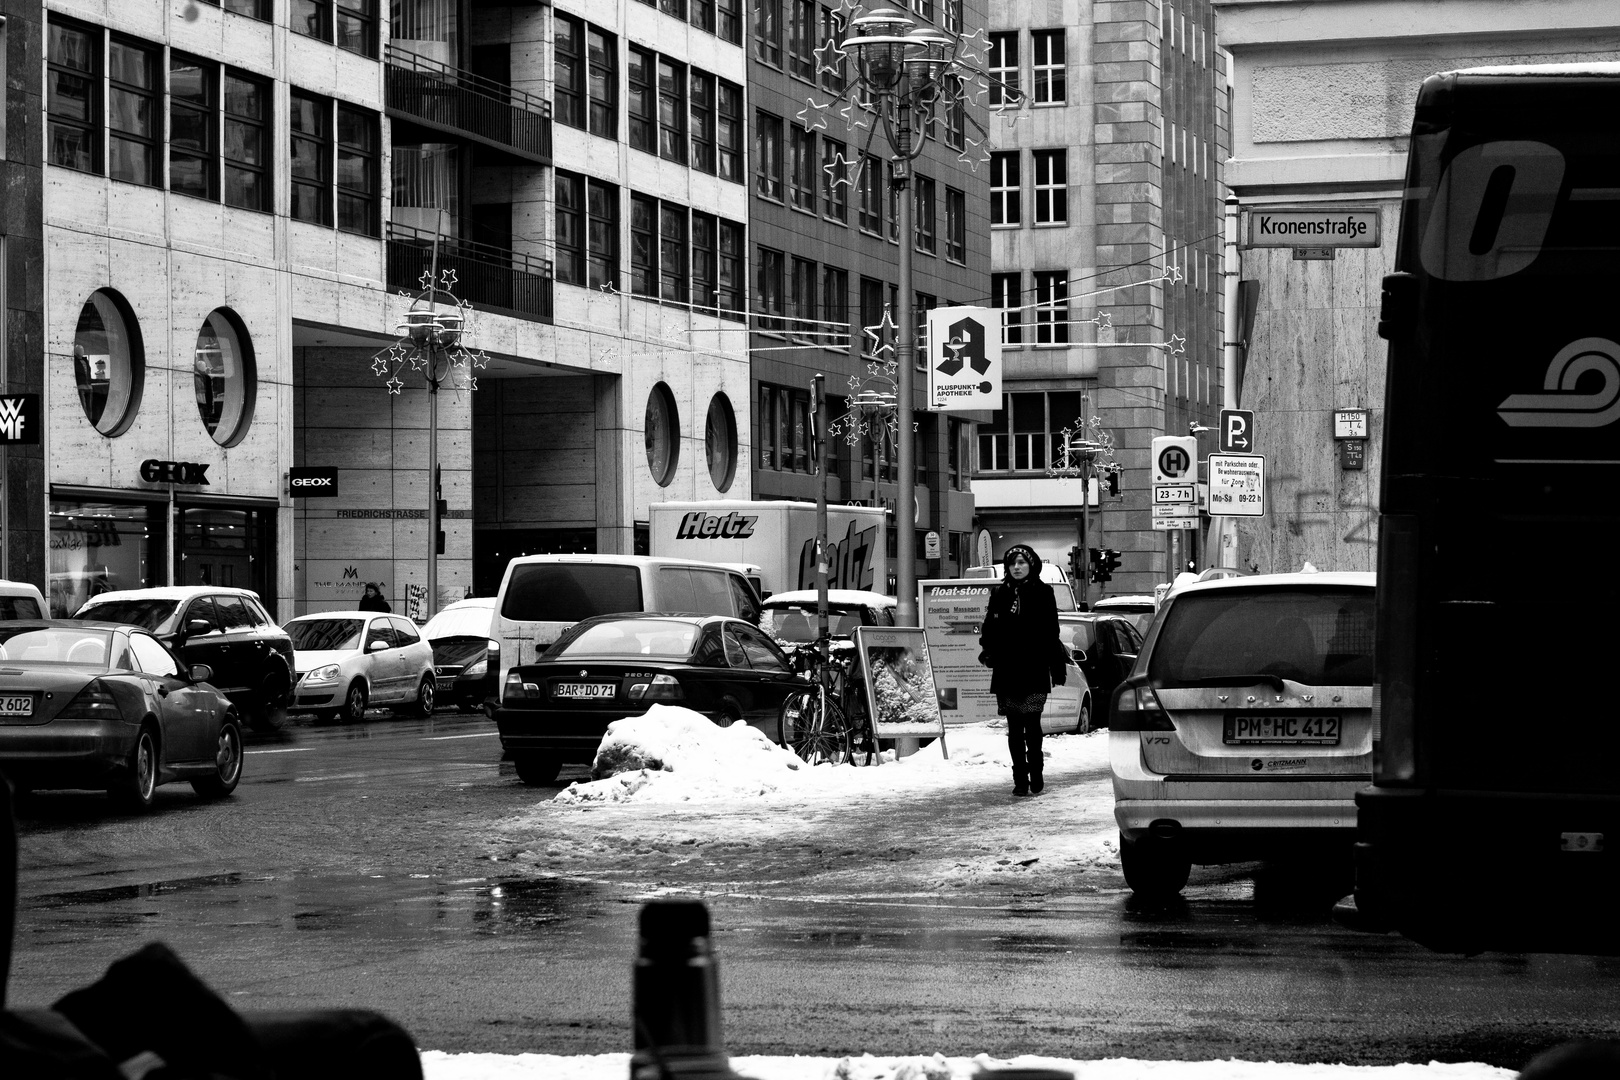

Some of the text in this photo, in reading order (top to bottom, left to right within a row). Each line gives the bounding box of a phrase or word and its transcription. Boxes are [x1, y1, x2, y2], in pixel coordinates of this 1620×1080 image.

[1260, 216, 1367, 238] Kronenstraße
[140, 459, 210, 485] GEOX
[291, 477, 332, 487] GEOX
[1160, 490, 1170, 499] 23
[1177, 490, 1182, 499] 7
[1184, 490, 1190, 499] h
[1212, 494, 1233, 503] Mo-Sa
[336, 510, 426, 518] FRIEDRICHSTRASSE
[676, 511, 759, 540] Hertz
[930, 586, 989, 596] float-store
[928, 606, 950, 614] Floating
[558, 685, 614, 696] BAR DO 71
[1218, 694, 1342, 703] VOLVO
[7, 698, 31, 712] 602
[1237, 718, 1338, 737] PM HC 412
